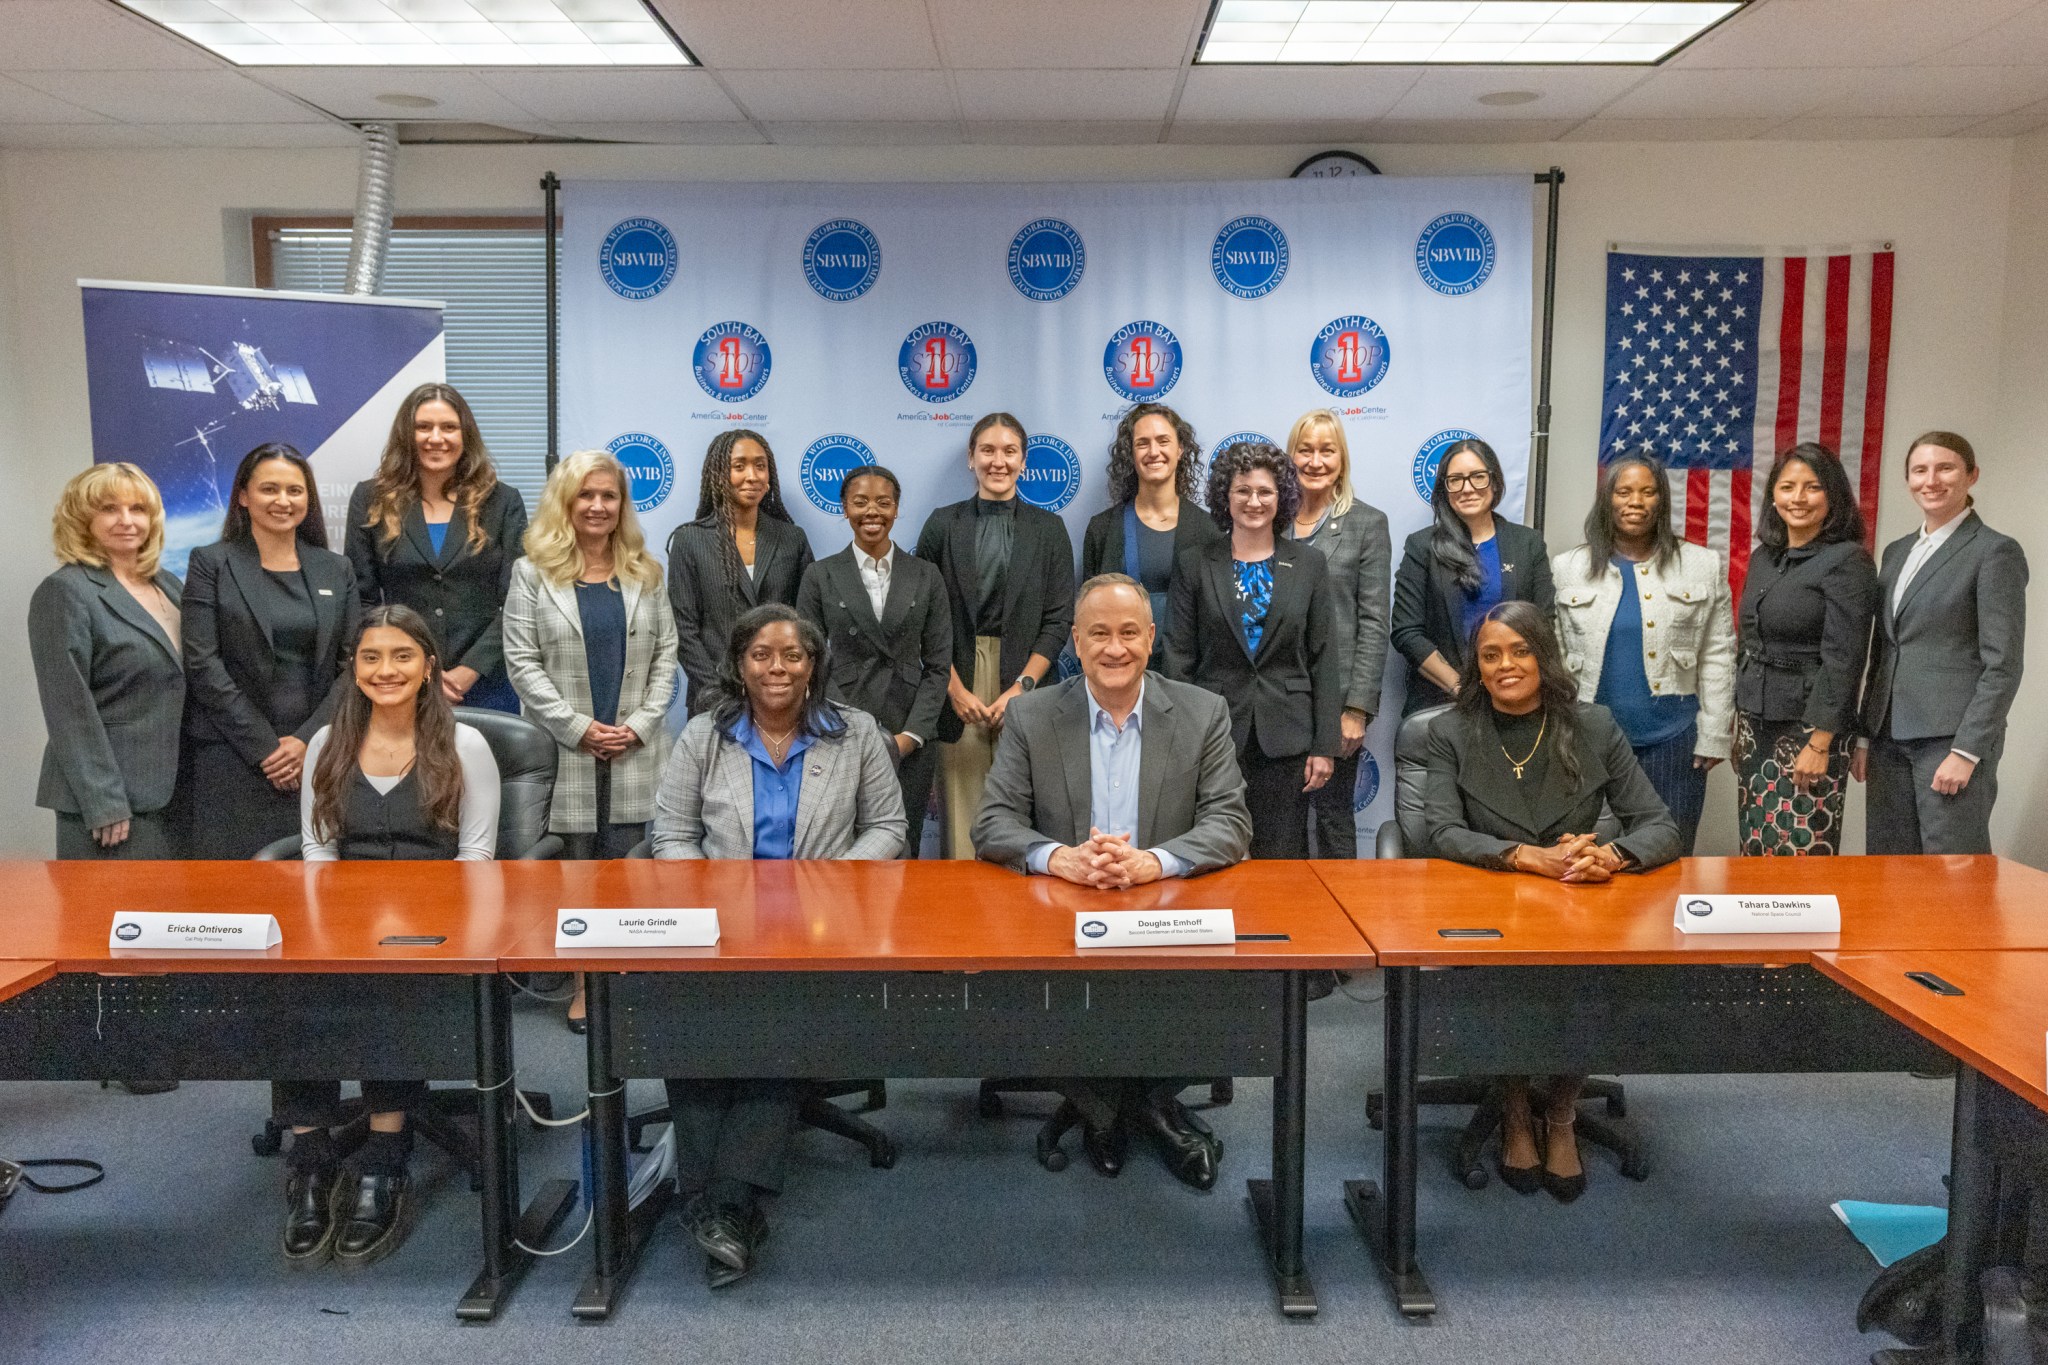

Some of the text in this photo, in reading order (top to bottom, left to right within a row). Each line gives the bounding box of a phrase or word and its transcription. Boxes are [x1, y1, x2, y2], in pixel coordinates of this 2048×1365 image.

[601, 219, 676, 299] SOUTH BAY WORKFORCE INVESTMENT BOARD
[613, 252, 664, 266] SBWIB
[804, 221, 879, 300] SOUTH BAY WORKFORCE INVESTMENT BOARD
[816, 254, 867, 268] SBWIB
[1009, 220, 1084, 300] SOUTH BAY WORKFORCE INVESTMENT BOARD
[1021, 254, 1071, 268] SBWIB
[1213, 218, 1288, 298] SOUTH BAY WORKFORCE INVESTMENT BOARD
[1225, 251, 1275, 265] SBWIB
[1417, 214, 1494, 294] SOUTH BAY WORKFORCE INVESTMENT BOARD
[1430, 248, 1481, 262] SBWIB
[700, 322, 767, 346] SOUTH BAY
[906, 322, 972, 347] SOUTH BAY
[1111, 321, 1178, 346] SOUTH BAY
[1318, 316, 1385, 343] SOUTH BAY
[703, 337, 765, 388] 1 STOP
[909, 337, 971, 389] 1 STOP
[1114, 336, 1176, 388] 1 STOP
[1321, 331, 1383, 383] 1 STOP
[694, 365, 716, 396] Business
[724, 393, 749, 402] Career
[750, 368, 769, 395] Centers
[900, 366, 975, 403] Business & Career Centers
[1105, 366, 1180, 402] Business & Career Centers
[1312, 360, 1388, 398] Business & Career Centers
[628, 466, 661, 480] WIB
[655, 447, 673, 504] INVESTMENT
[801, 436, 864, 508] SOUTH BAY WORKFORCE
[814, 468, 852, 482] SBW
[1027, 436, 1079, 504] RKFORCE INVESTMENT
[1415, 455, 1425, 471] BAY
[1415, 475, 1431, 500] OUTH
[634, 501, 654, 511] BOA
[1360, 751, 1375, 762] AY
[1358, 784, 1377, 808] Centers
[1738, 901, 1811, 909] Tahara Dawkins
[167, 924, 242, 934] Ericka Ontiveros
[619, 918, 677, 926] Laurie Grindle
[1138, 919, 1203, 929] Douglas Emhoff
